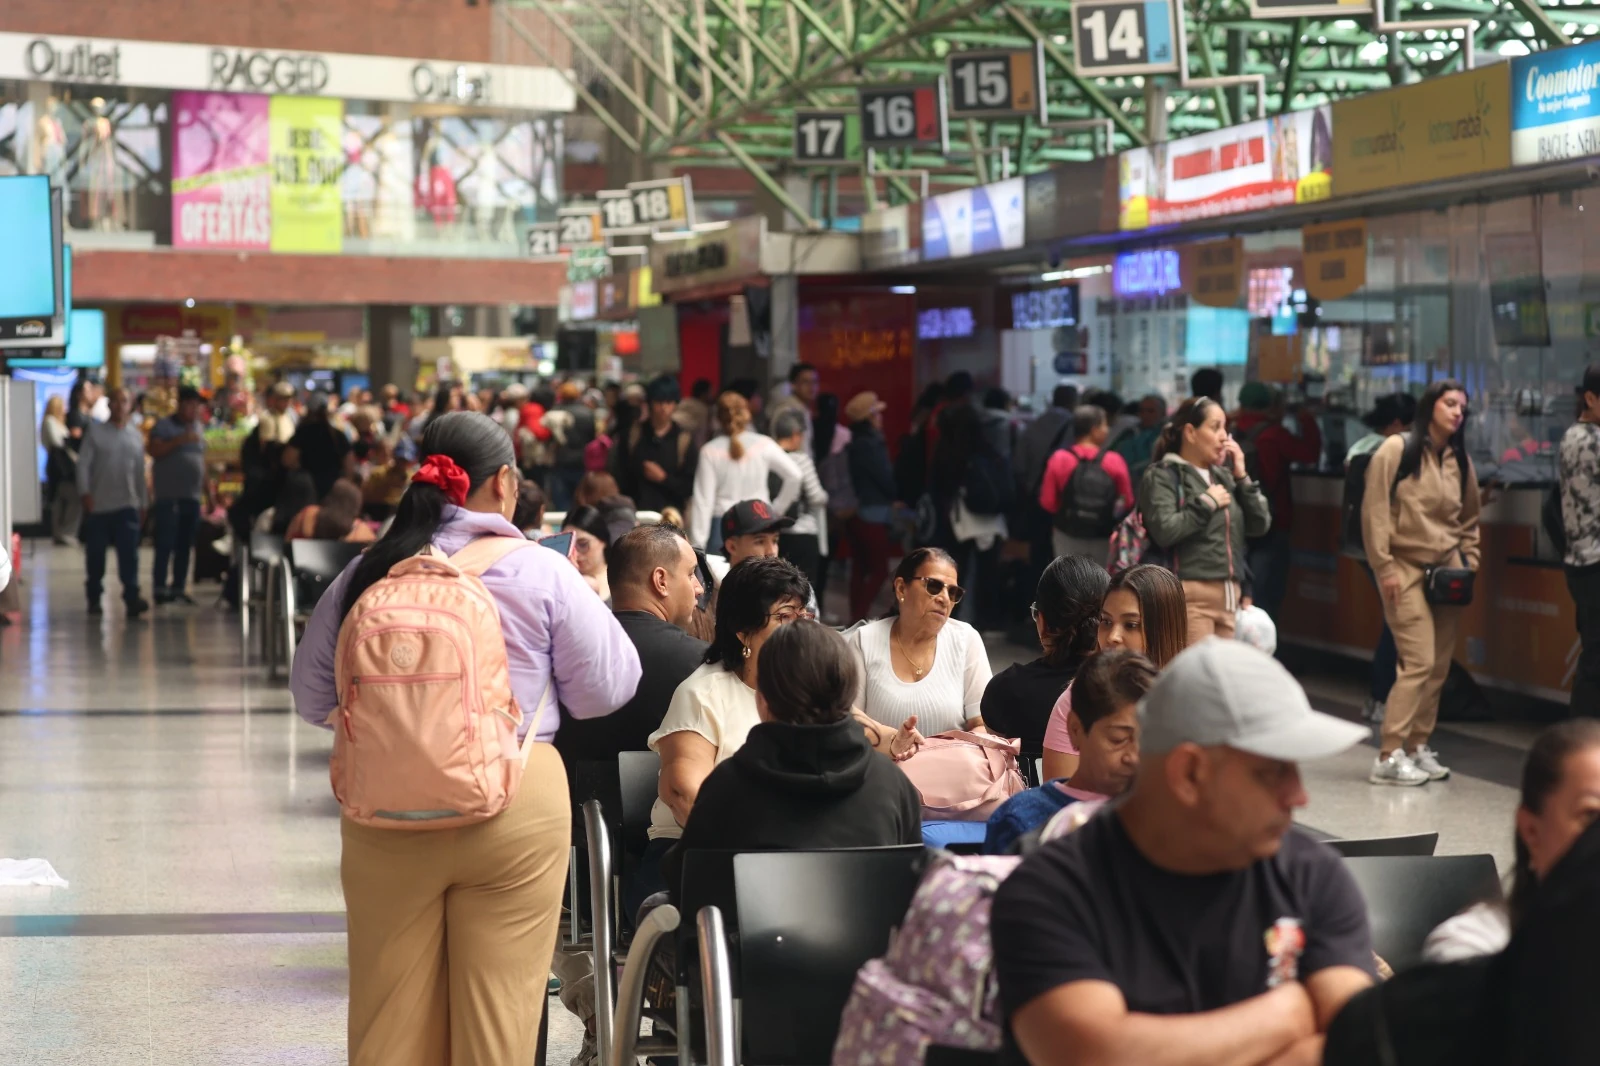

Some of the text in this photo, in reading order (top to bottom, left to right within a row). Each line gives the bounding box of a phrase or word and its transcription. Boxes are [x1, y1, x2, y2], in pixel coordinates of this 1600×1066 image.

[1081, 9, 1145, 62] 14
[25, 37, 121, 81] Outlet
[209, 48, 330, 93] RAGGED
[955, 60, 1009, 107] 15
[1525, 58, 1600, 103] Coomotor
[799, 119, 844, 156] 17
[866, 96, 916, 138] 16
[179, 201, 271, 244] OFERTAS
[603, 198, 636, 228] 19
[634, 188, 670, 222] 18
[528, 230, 558, 256] 21
[560, 215, 593, 243] 20
